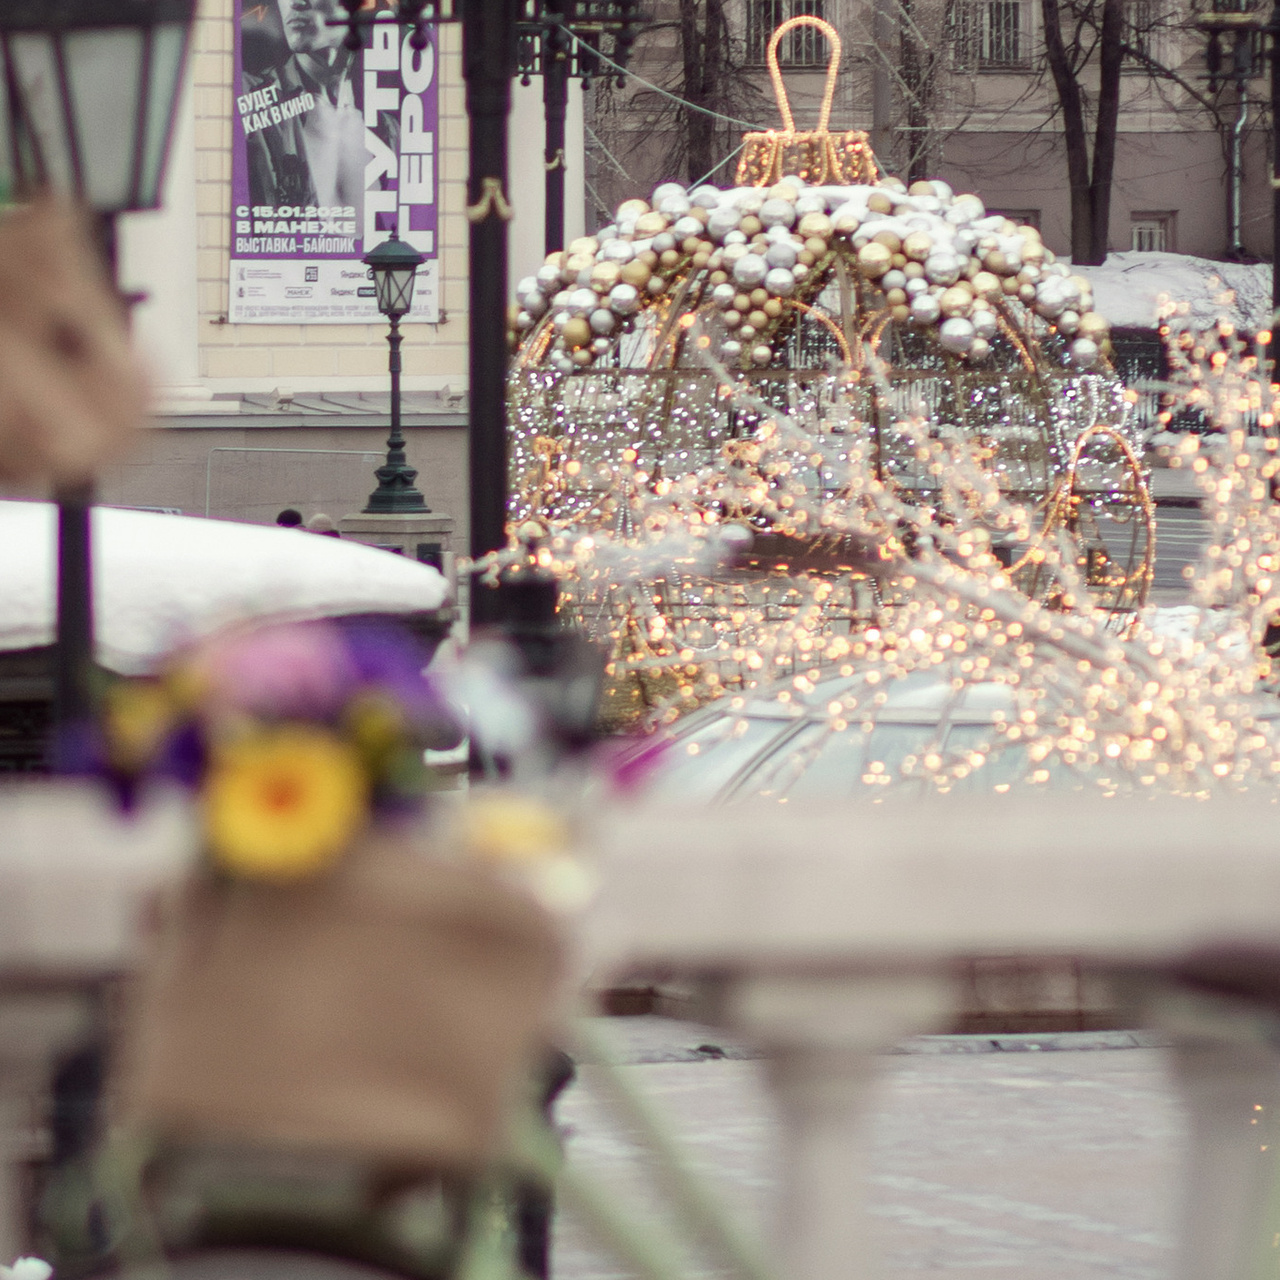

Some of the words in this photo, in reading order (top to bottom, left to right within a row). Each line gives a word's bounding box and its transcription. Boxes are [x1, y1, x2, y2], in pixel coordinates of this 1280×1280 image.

[237, 84, 279, 115] БУДЕТ
[241, 109, 273, 135] КАК
[270, 106, 282, 124] В
[281, 92, 315, 121] КИНО
[363, 10, 401, 253] ПУТЬ
[399, 4, 435, 253] ГЕРО
[236, 221, 251, 234] В
[254, 221, 356, 234] МАНЕЖЕ
[251, 205, 356, 218] 15.01.2022
